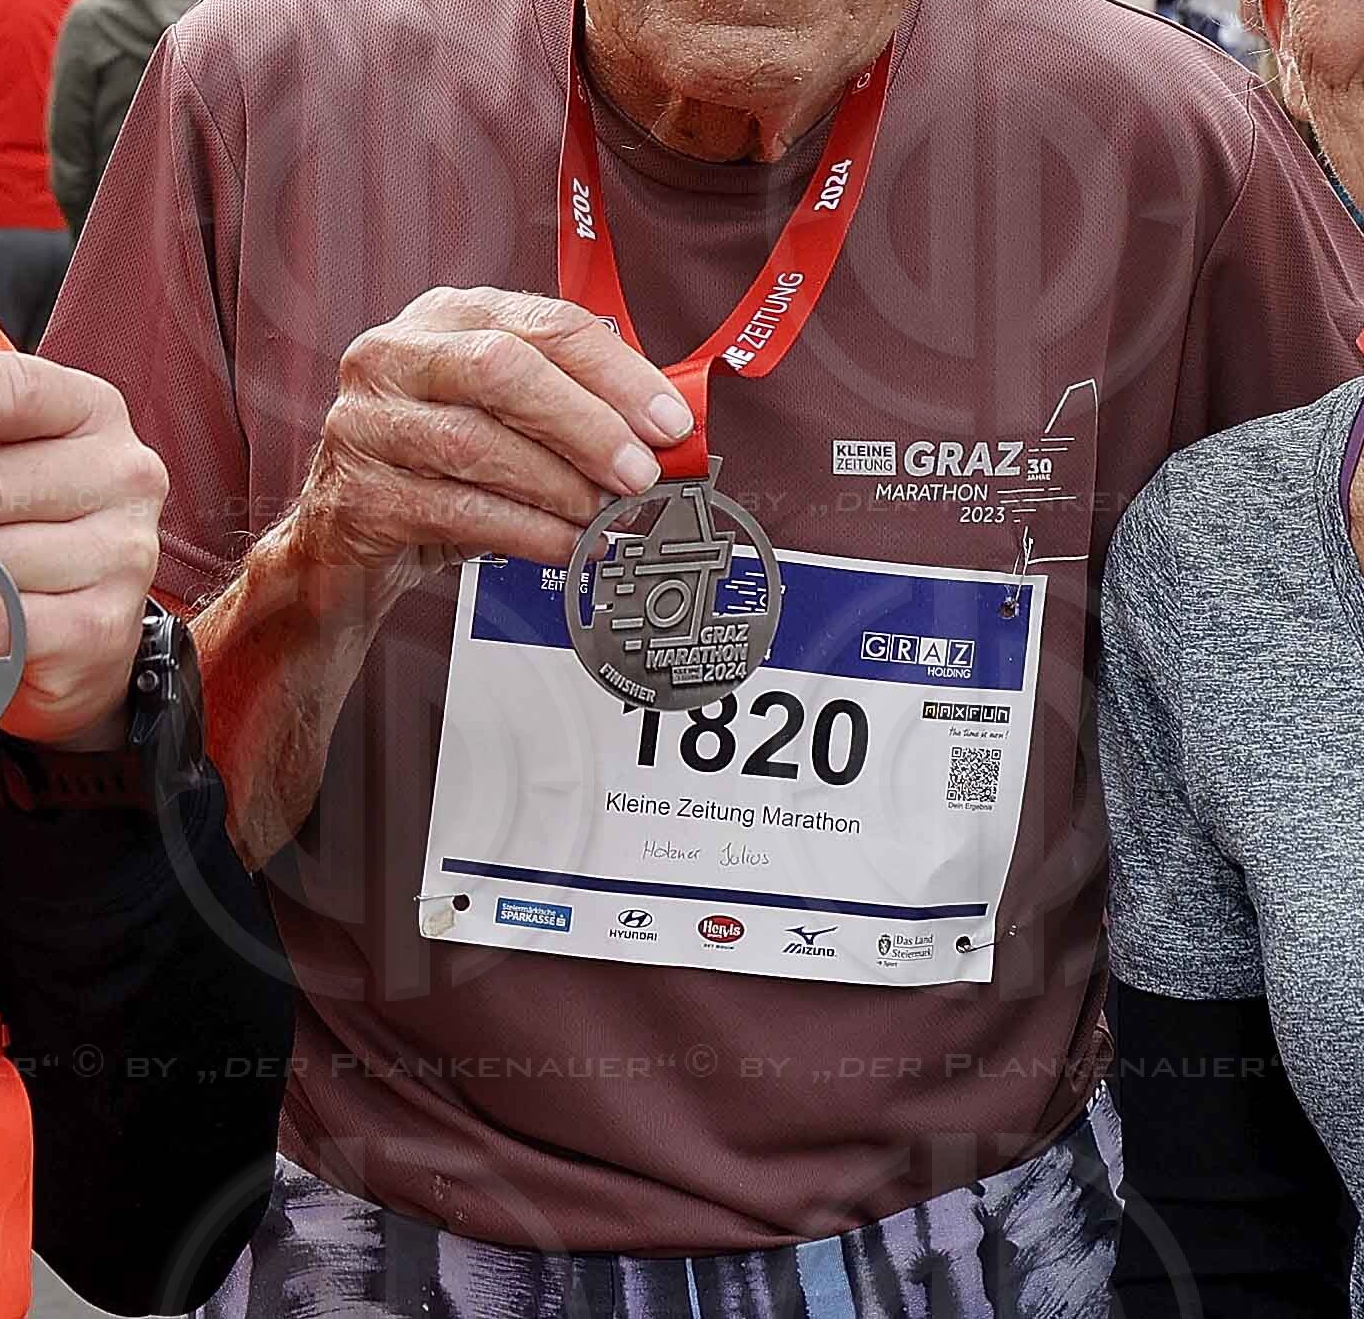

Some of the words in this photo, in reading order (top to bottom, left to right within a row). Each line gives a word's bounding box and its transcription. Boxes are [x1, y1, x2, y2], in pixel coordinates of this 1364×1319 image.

[572, 177, 596, 241] 2024
[736, 271, 804, 351] ZEITUNG
[813, 158, 853, 212] 2024
[836, 444, 893, 458] KLEINE
[903, 440, 1025, 478] GRAZ
[835, 457, 893, 472] ZEITUNG
[1027, 457, 1053, 475] 30
[874, 483, 989, 502] MARATHON
[958, 506, 1006, 524] 2023
[541, 567, 590, 583] KLEE
[540, 580, 589, 594] ZEITG
[700, 623, 750, 645] GRAZ
[645, 643, 749, 670] MARATHON
[863, 634, 973, 667] GRAZ
[702, 661, 748, 682] 2024
[927, 666, 972, 679] HOLDING
[598, 662, 657, 703] FINISHER
[923, 702, 1010, 722] MAXFUN
[622, 690, 870, 787] 1820
[605, 791, 671, 816] Kleine
[677, 798, 755, 828] Zeitung
[762, 805, 861, 834] Marathon
[947, 801, 964, 809] Dein
[719, 840, 770, 868] Julius
[501, 911, 555, 926] SPARKASSE
[608, 928, 658, 942] HYUNDAI
[703, 920, 741, 938] Hervis
[896, 934, 913, 945] Das
[914, 934, 934, 945] Land
[782, 942, 836, 958] MIZUNO
[891, 947, 932, 959] Steiermark
